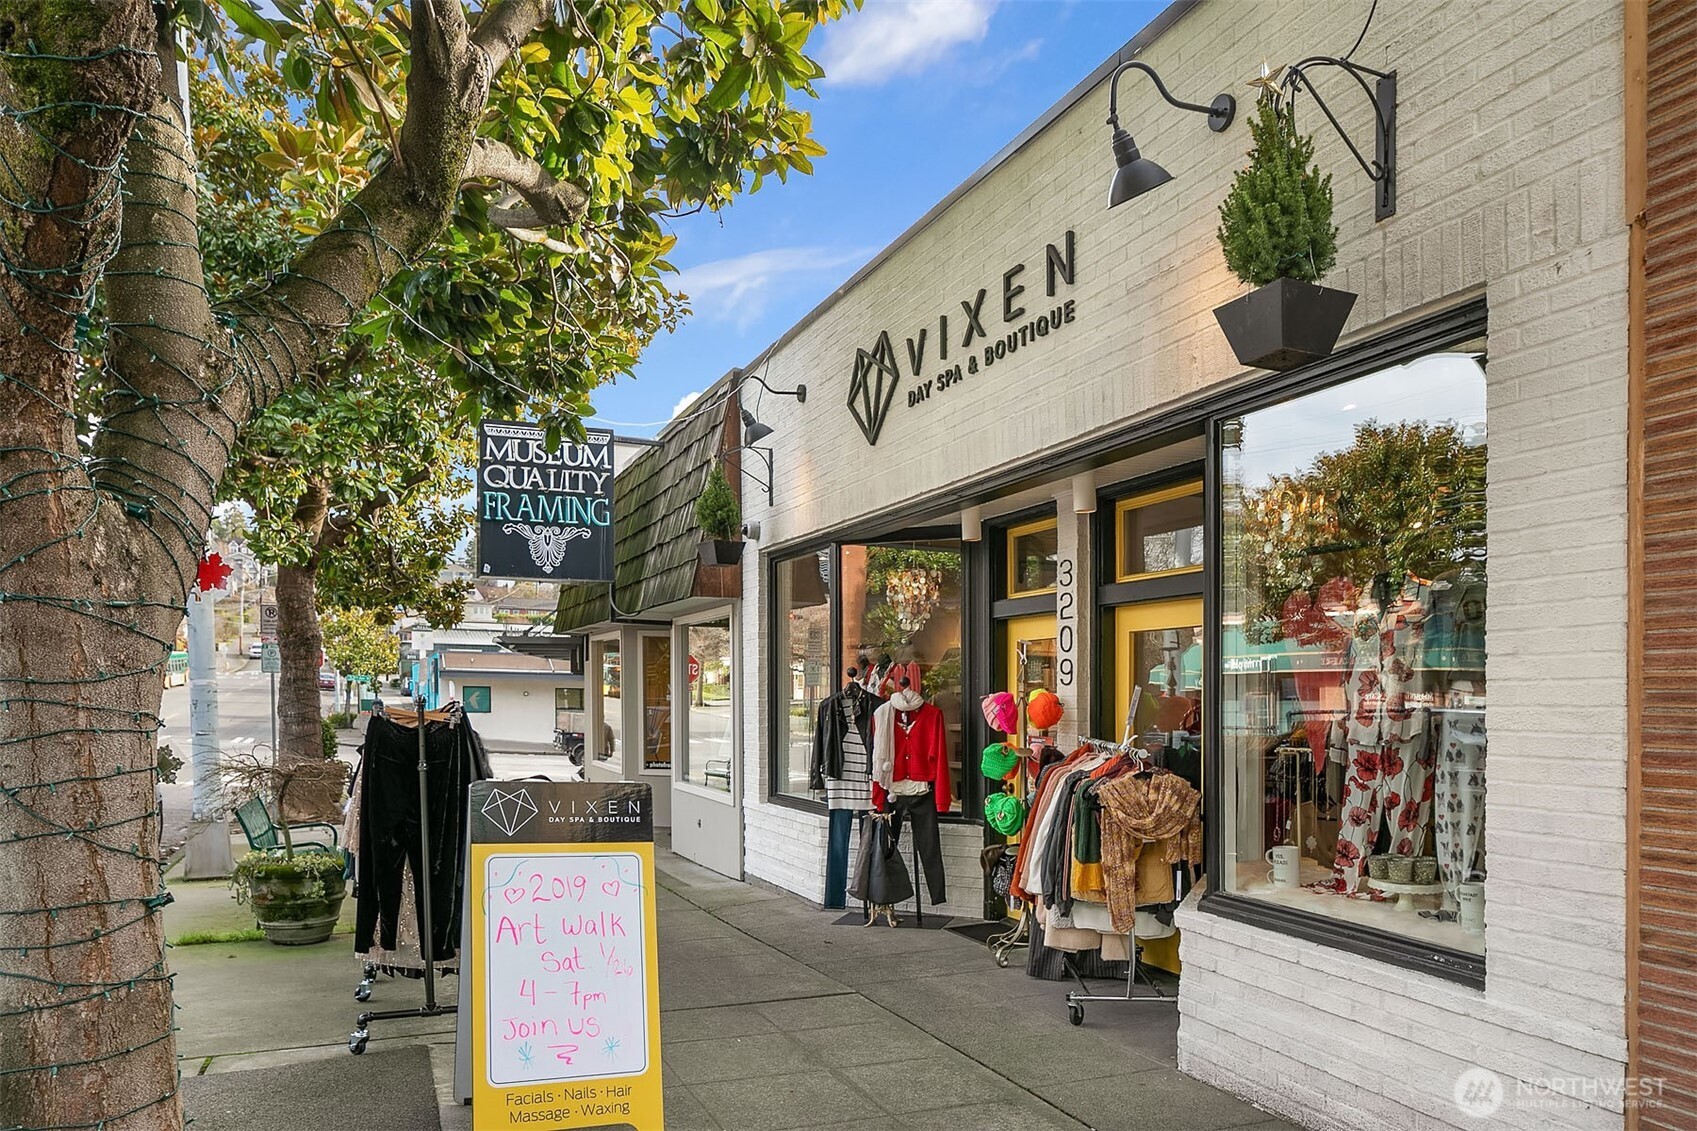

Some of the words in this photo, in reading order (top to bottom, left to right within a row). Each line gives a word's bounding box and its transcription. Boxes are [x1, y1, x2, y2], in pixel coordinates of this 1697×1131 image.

[906, 230, 1075, 376] VIXEN
[907, 380, 933, 408] DAY
[936, 364, 963, 392] SPA
[967, 355, 979, 375] &
[984, 299, 1076, 367] BOUTIQUE
[483, 437, 612, 469] MUSEUM
[483, 464, 611, 496] QUALITY
[483, 491, 611, 526] FRAMING
[1059, 559, 1074, 686] 3209
[548, 800, 641, 814] VIXEN
[529, 873, 587, 903] 2019
[495, 912, 548, 946] Art
[541, 946, 586, 974] Sat
[519, 978, 536, 1006] 4
[562, 980, 607, 1010] 7pm
[502, 1016, 559, 1041] Join
[506, 1089, 554, 1106] Facials
[564, 1086, 597, 1101] Nails
[606, 1085, 633, 1098] Hair
[509, 1106, 571, 1124] Massage
[580, 1101, 630, 1117] Waxing
